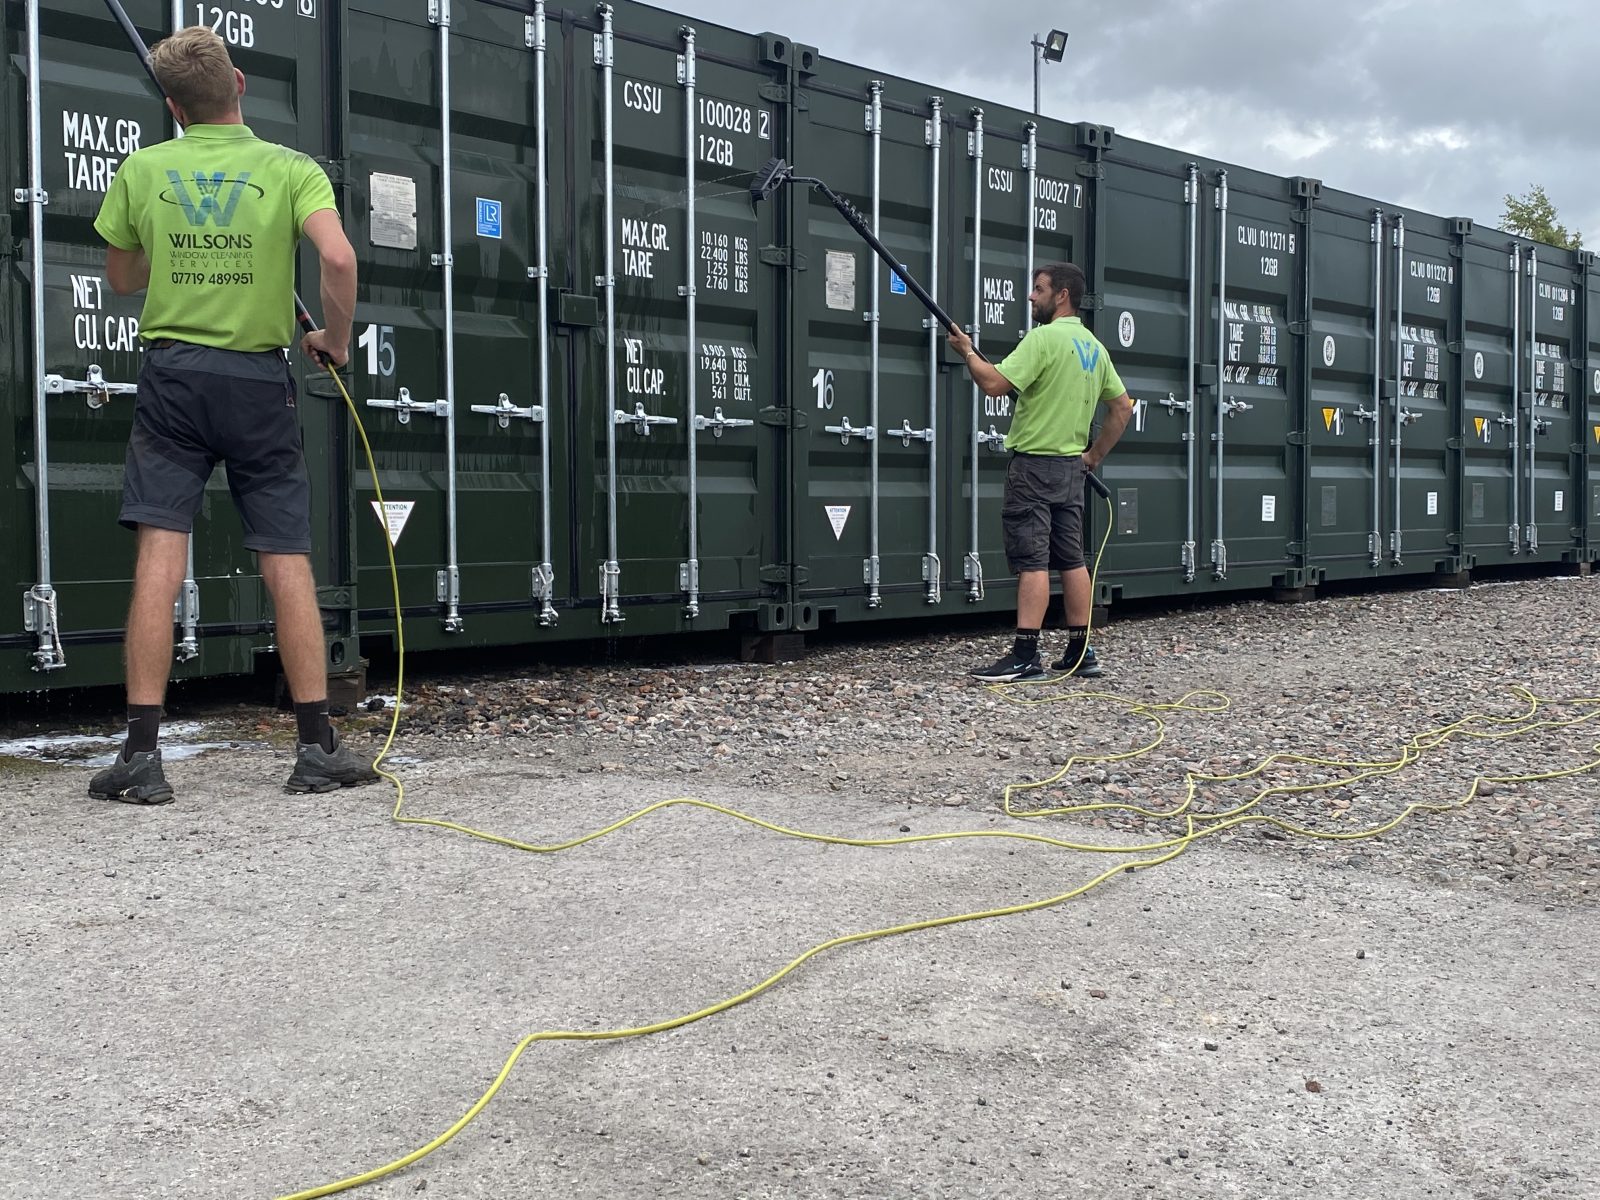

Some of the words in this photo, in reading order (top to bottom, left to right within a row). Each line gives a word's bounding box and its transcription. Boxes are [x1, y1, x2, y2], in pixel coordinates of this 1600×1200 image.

[197, 3, 254, 48] 12GB
[624, 80, 662, 114] CSSU
[699, 98, 751, 134] 100028
[760, 112, 768, 137] 2
[699, 134, 733, 167] 12GB
[988, 167, 1013, 193] CSSU
[1034, 176, 1070, 205] 100027
[1075, 185, 1081, 207] 7
[1034, 206, 1057, 231] 12GB
[168, 233, 253, 249] WILSONS
[622, 217, 670, 251] MAX.GR.
[701, 231, 728, 247] 10.160
[735, 236, 748, 251] KGS
[1238, 225, 1257, 246] CLVU
[1260, 229, 1286, 251] 011271
[1289, 235, 1295, 254] 5
[169, 251, 209, 259] WINDOW
[210, 251, 253, 259] CLEANING
[170, 260, 254, 268] SERVICES
[622, 249, 654, 279] TARE
[700, 246, 728, 262] 22.400
[734, 251, 748, 265] LBS
[706, 260, 728, 276] 1.255
[735, 265, 748, 280] KGS
[1260, 256, 1278, 277] 12GB
[1410, 260, 1425, 278] CLVU
[1426, 263, 1447, 282] 011272
[171, 272, 205, 285] 07719
[208, 272, 254, 285] 489951
[706, 276, 728, 291] 2.760
[734, 280, 748, 293] LBS
[70, 274, 102, 310] NET
[983, 277, 1015, 302] MAX.GR.
[1427, 286, 1441, 304] 12GB
[984, 302, 1005, 325] TARE
[1228, 322, 1244, 342] TARE
[358, 323, 396, 377] 15
[624, 337, 644, 365] NET
[702, 344, 726, 357] 8.905
[731, 347, 747, 359] KGS
[1228, 342, 1241, 362] NET
[1403, 344, 1415, 360] TARE
[700, 356, 727, 371] 19.640
[734, 360, 747, 373] LBS
[1402, 360, 1413, 377] NET
[711, 372, 727, 385] 15.9
[812, 368, 835, 410] 16
[712, 386, 727, 400] 561
[1132, 399, 1148, 433] 17
[1333, 407, 1345, 436] 18
